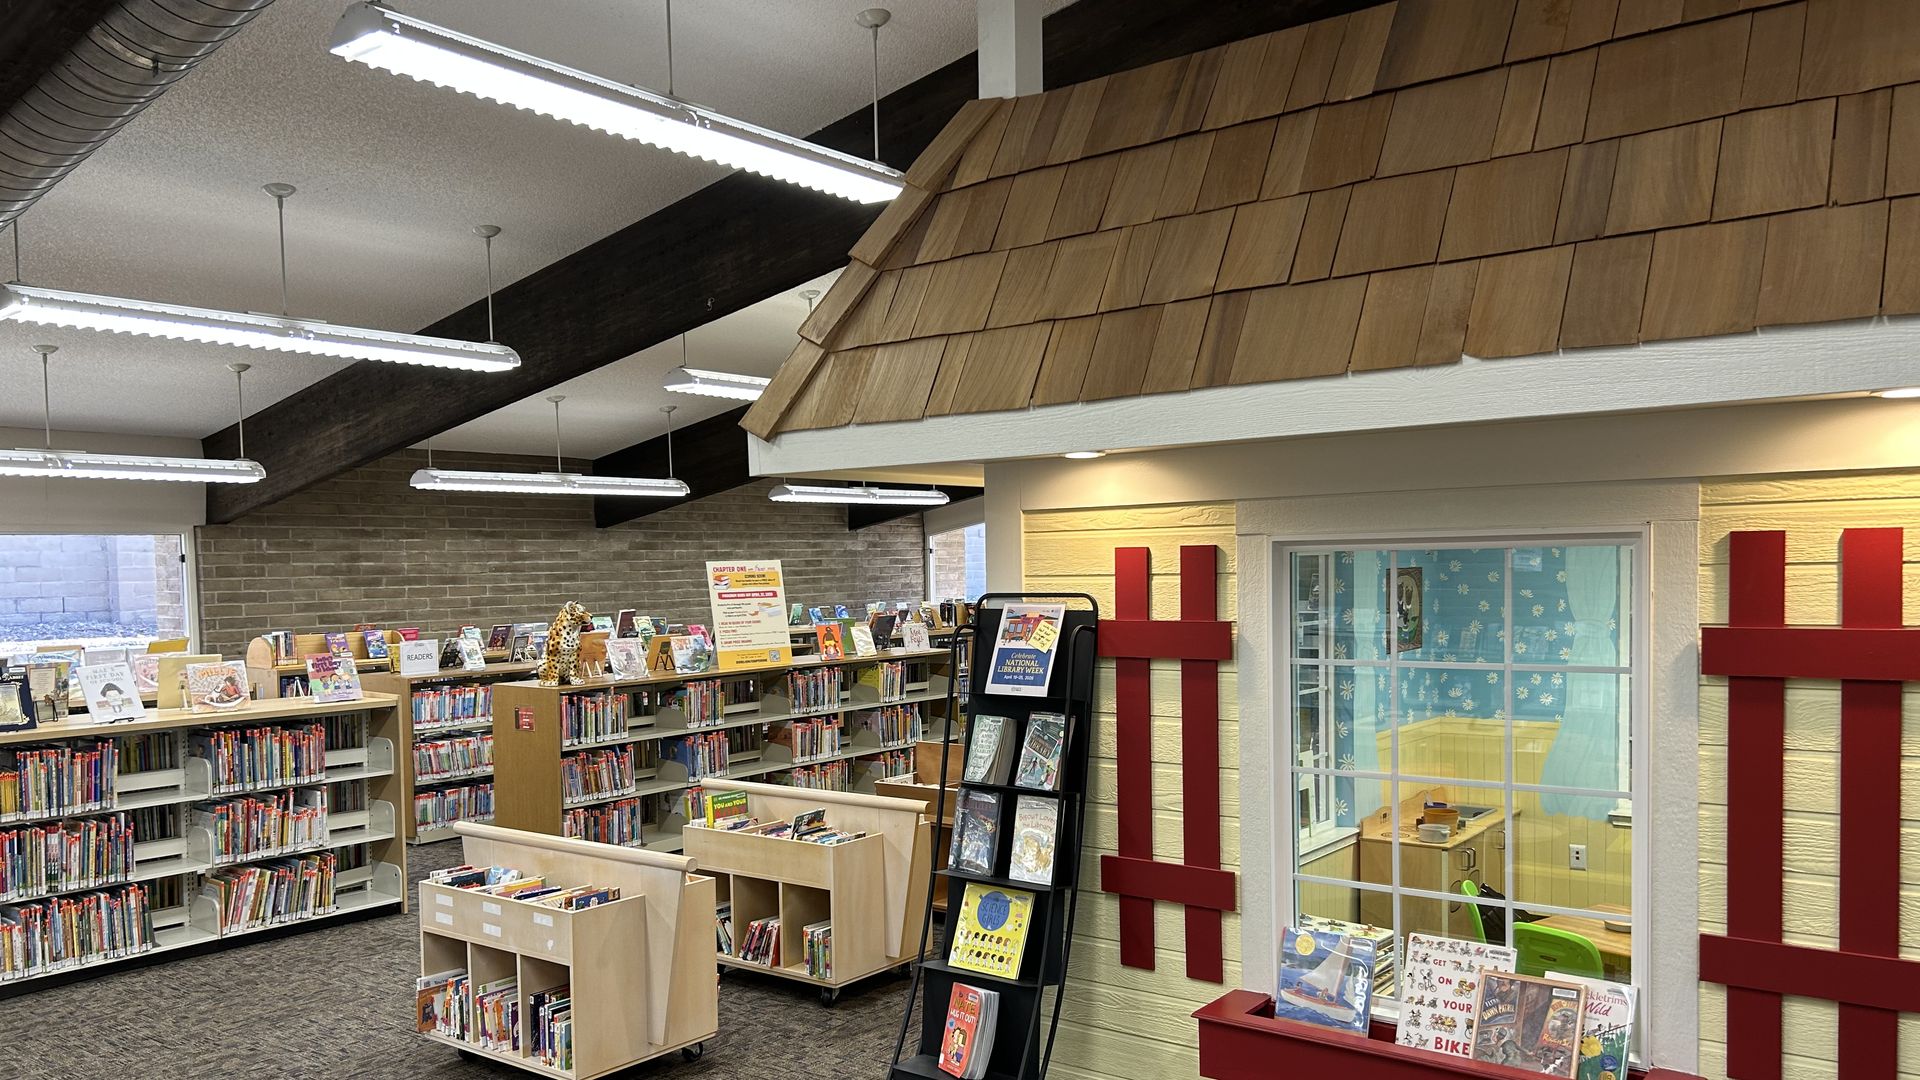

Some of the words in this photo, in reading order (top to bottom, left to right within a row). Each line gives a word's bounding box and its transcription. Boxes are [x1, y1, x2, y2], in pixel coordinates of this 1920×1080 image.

[406, 652, 433, 661] READERS
[1011, 652, 1037, 660] Celebrate
[1005, 659, 1039, 667] NATIONAL
[997, 666, 1025, 674] LIBRARY
[1025, 666, 1044, 674] WEEK
[980, 902, 1007, 916] SCIENCE
[982, 913, 1000, 926] GIRLS
[1433, 958, 1446, 967] GET
[1438, 976, 1453, 985] ON
[954, 997, 976, 1015] NATE
[1442, 1000, 1473, 1013] YOUR
[1584, 1001, 1612, 1017] Wild
[959, 1011, 965, 1020] IT
[1434, 1036, 1471, 1056] BIKE
